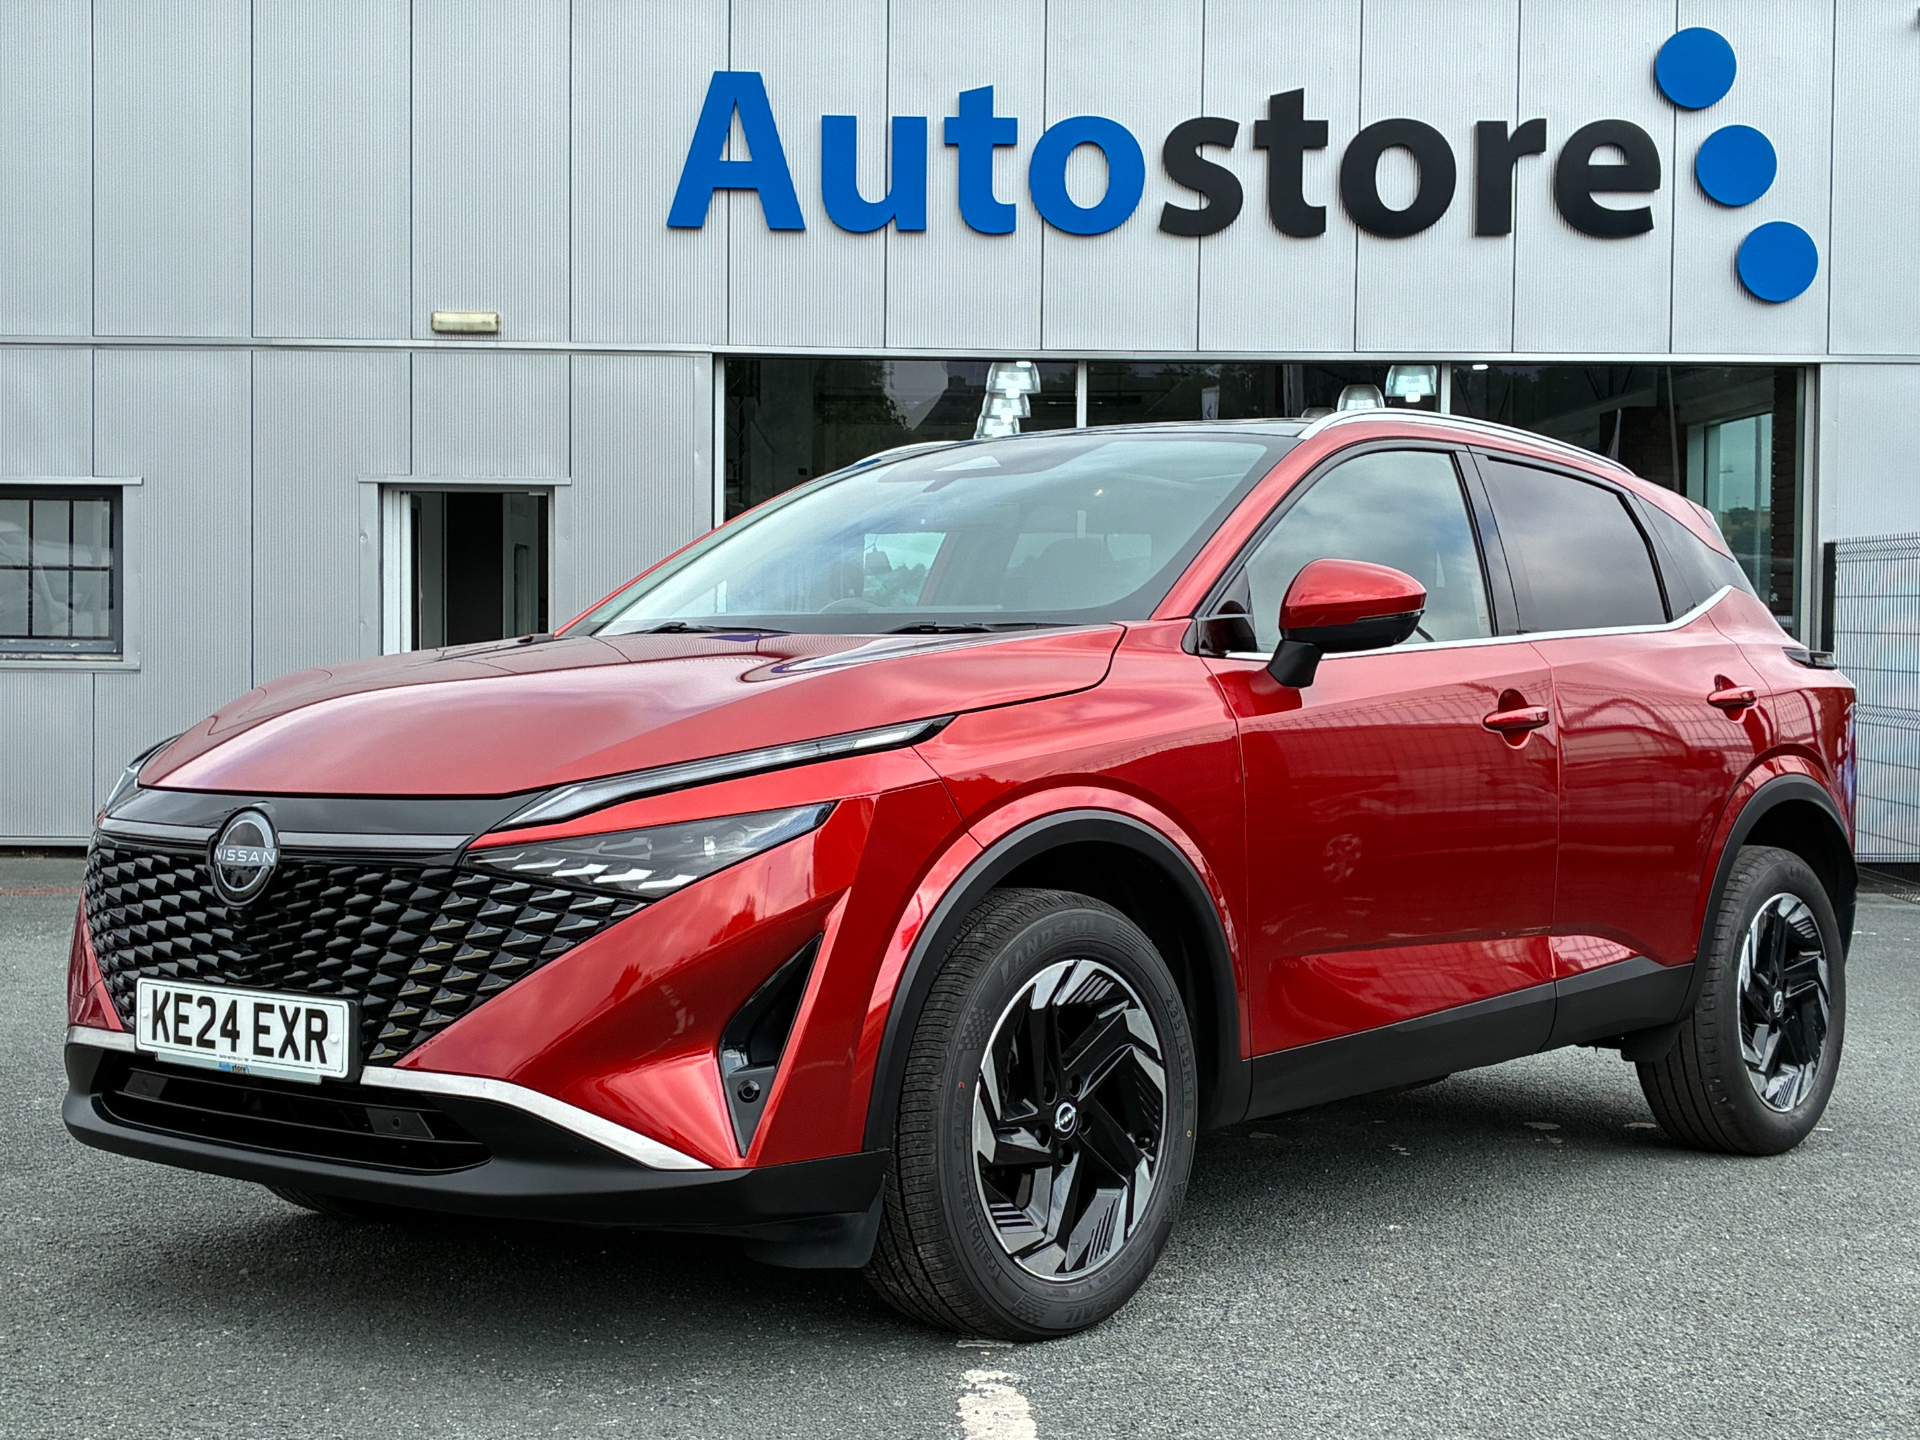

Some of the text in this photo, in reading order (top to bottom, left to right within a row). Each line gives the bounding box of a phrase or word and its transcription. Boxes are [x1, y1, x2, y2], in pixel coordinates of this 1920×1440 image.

[667, 71, 1661, 240] Autostore
[214, 847, 276, 863] NISSAN
[999, 919, 1097, 981] LANDSAIL
[151, 989, 328, 1064] KE24 EXR
[955, 1170, 1003, 1284] Trailblazer
